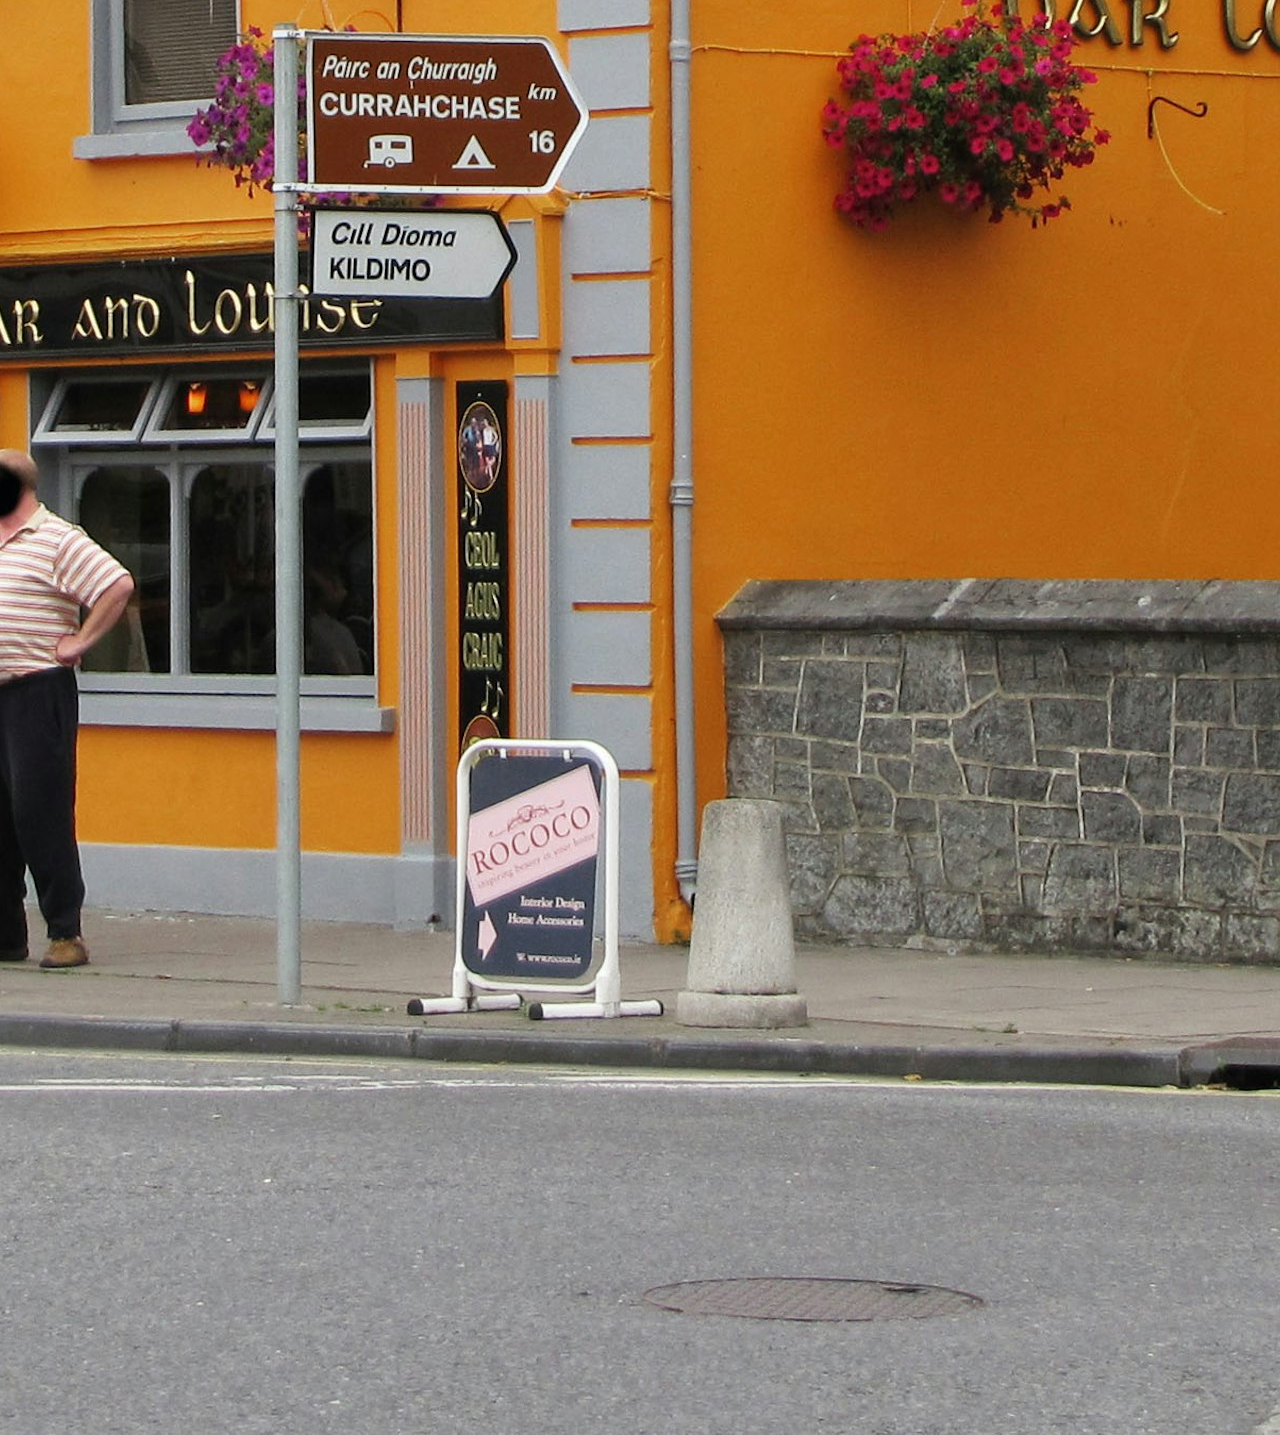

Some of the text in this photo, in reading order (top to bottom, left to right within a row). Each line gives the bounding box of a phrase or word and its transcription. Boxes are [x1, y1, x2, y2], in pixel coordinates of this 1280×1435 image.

[322, 55, 497, 85] Páirc an Churraigh
[528, 83, 557, 101] km
[319, 92, 521, 121] CURRAHCHASE
[528, 130, 556, 155] 16
[331, 221, 373, 245] Cill
[329, 257, 431, 282] KILDIMO
[464, 531, 500, 569] CEOL
[465, 582, 501, 620] AGUS
[463, 632, 503, 670] CRAIC
[471, 805, 591, 874] ROCOCO
[520, 895, 585, 911] Interior Design
[507, 912, 584, 926] Home Accessories
